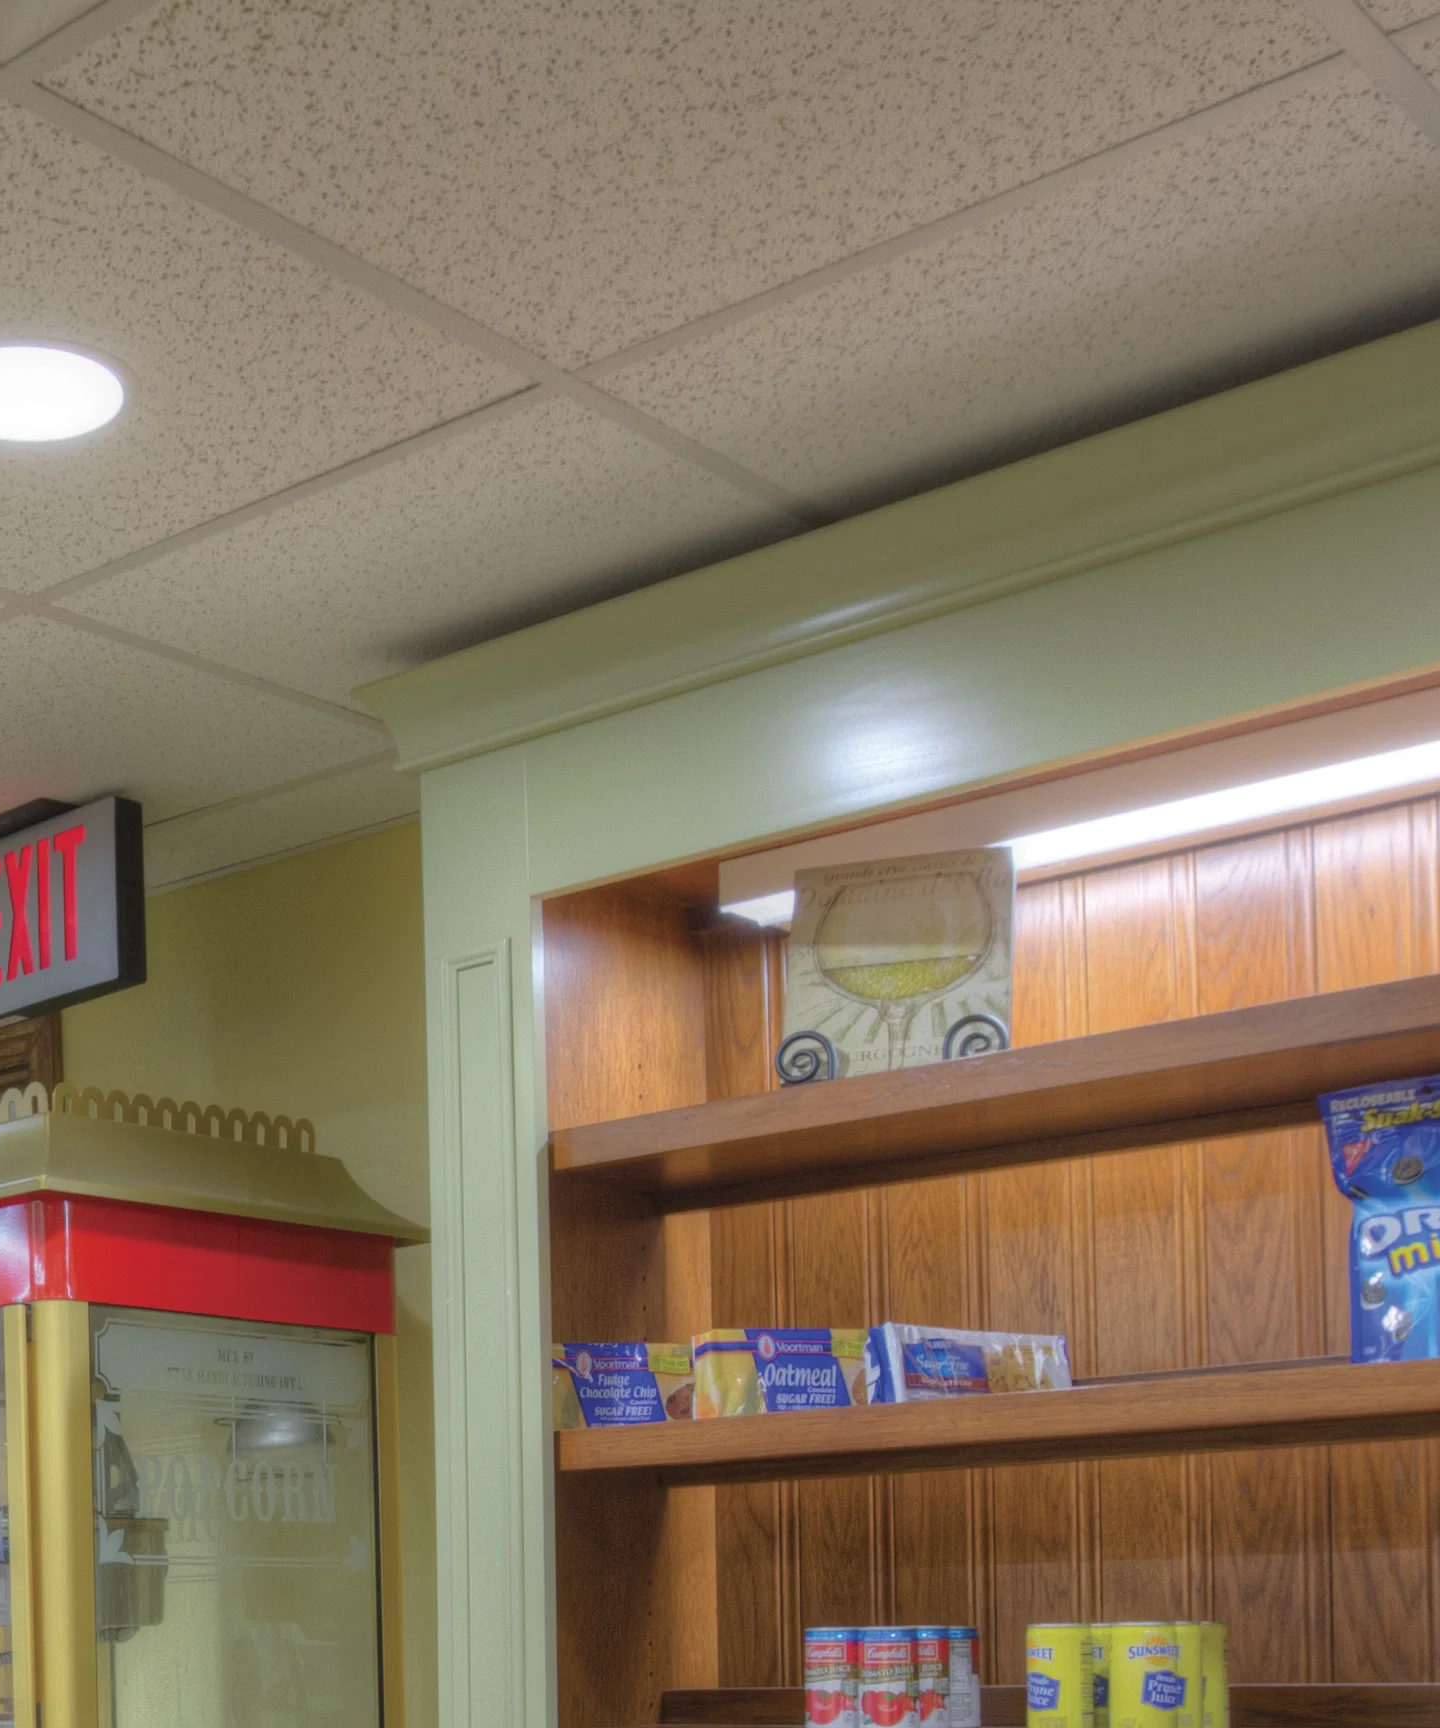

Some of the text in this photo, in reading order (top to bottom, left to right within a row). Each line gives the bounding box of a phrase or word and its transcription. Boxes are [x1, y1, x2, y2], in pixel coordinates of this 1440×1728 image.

[1330, 1089, 1416, 1113] RECLOSEABLE
[776, 1343, 823, 1352] Voortman
[593, 1360, 640, 1369] Voortman
[598, 1374, 630, 1387] Fudge
[764, 1363, 837, 1387] Oatmeal
[580, 1386, 657, 1399] Chocolate Chip
[776, 1393, 835, 1404] SUGAR FREE!
[594, 1406, 652, 1417] SUGAR FREE!
[136, 1454, 338, 1524] POPCORN
[1128, 1645, 1181, 1660] SUNSWEET
[829, 1664, 852, 1674] JUICE
[1147, 1681, 1182, 1696] Prune
